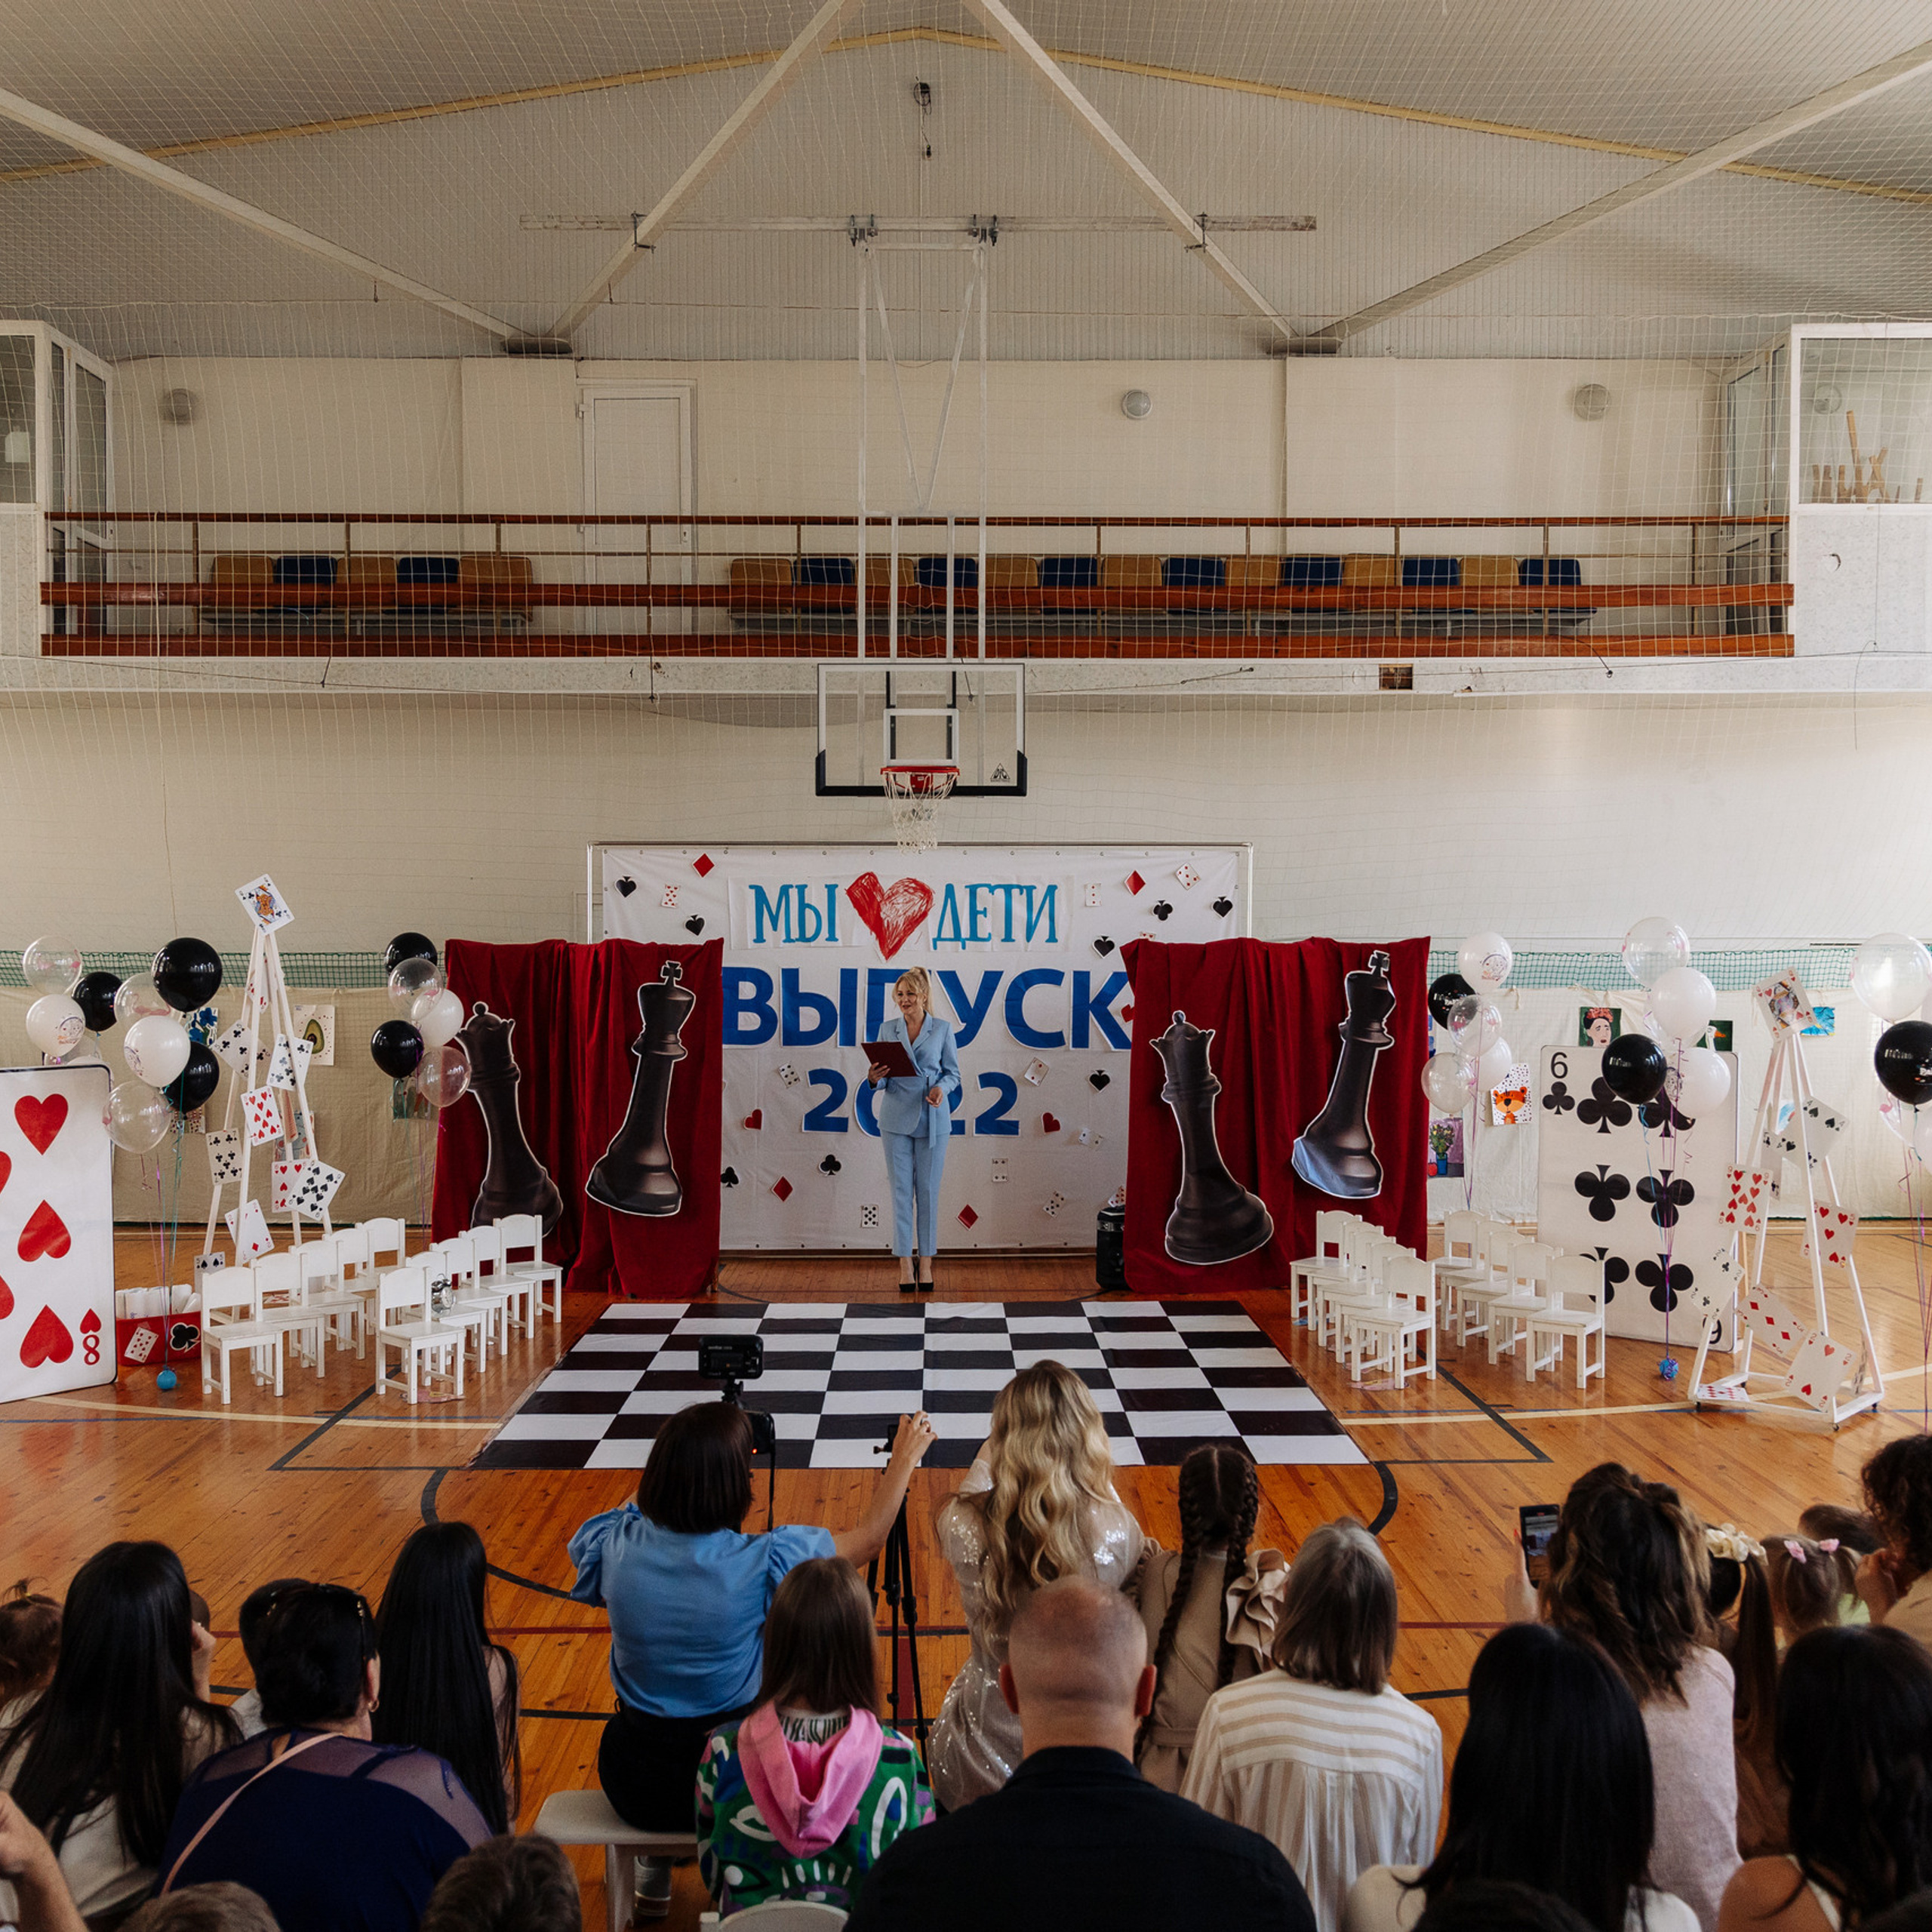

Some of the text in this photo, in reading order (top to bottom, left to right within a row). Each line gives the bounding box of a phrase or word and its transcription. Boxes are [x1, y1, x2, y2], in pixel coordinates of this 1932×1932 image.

[749, 883, 1058, 950] МЫ ДЕТИ
[1551, 1051, 1568, 1079] 6
[82, 1334, 100, 1365] 8
